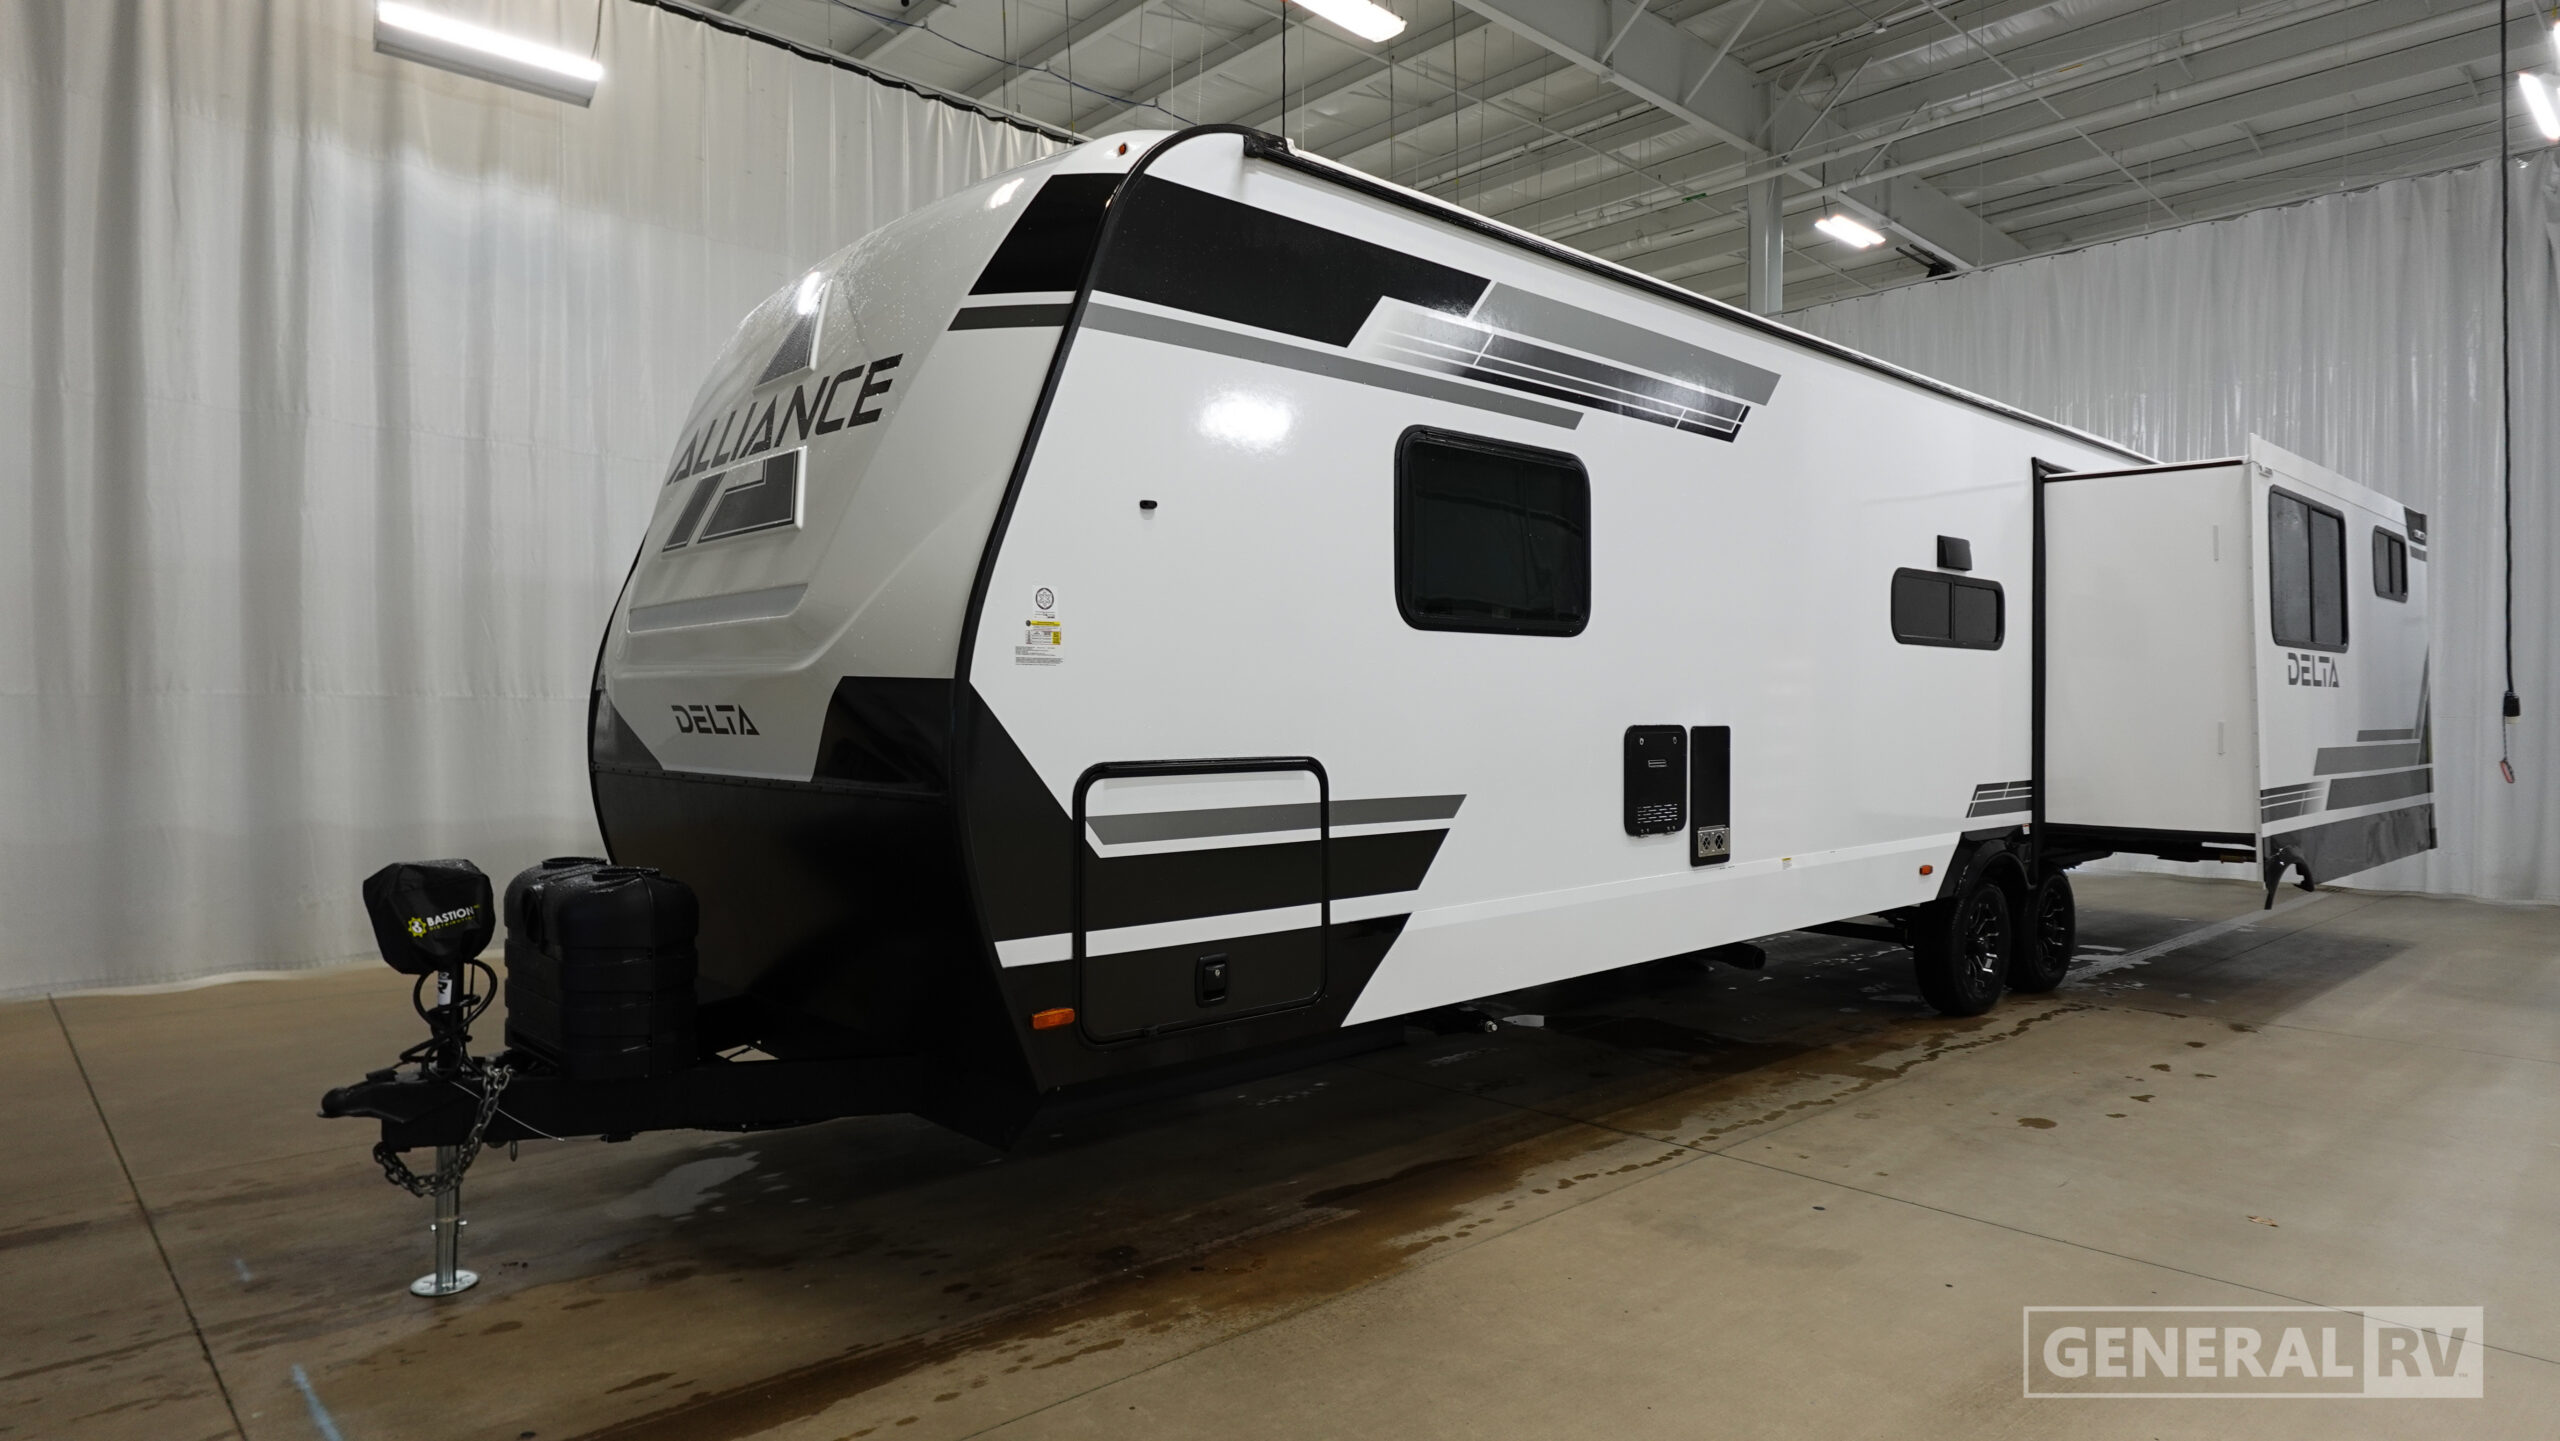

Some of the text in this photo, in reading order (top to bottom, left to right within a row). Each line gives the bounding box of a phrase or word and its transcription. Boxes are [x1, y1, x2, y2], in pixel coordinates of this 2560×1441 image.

[666, 353, 904, 486] ALLIANCE
[2287, 652, 2339, 688] DELTA
[671, 704, 760, 735] DELTA
[426, 906, 474, 927] BASTION
